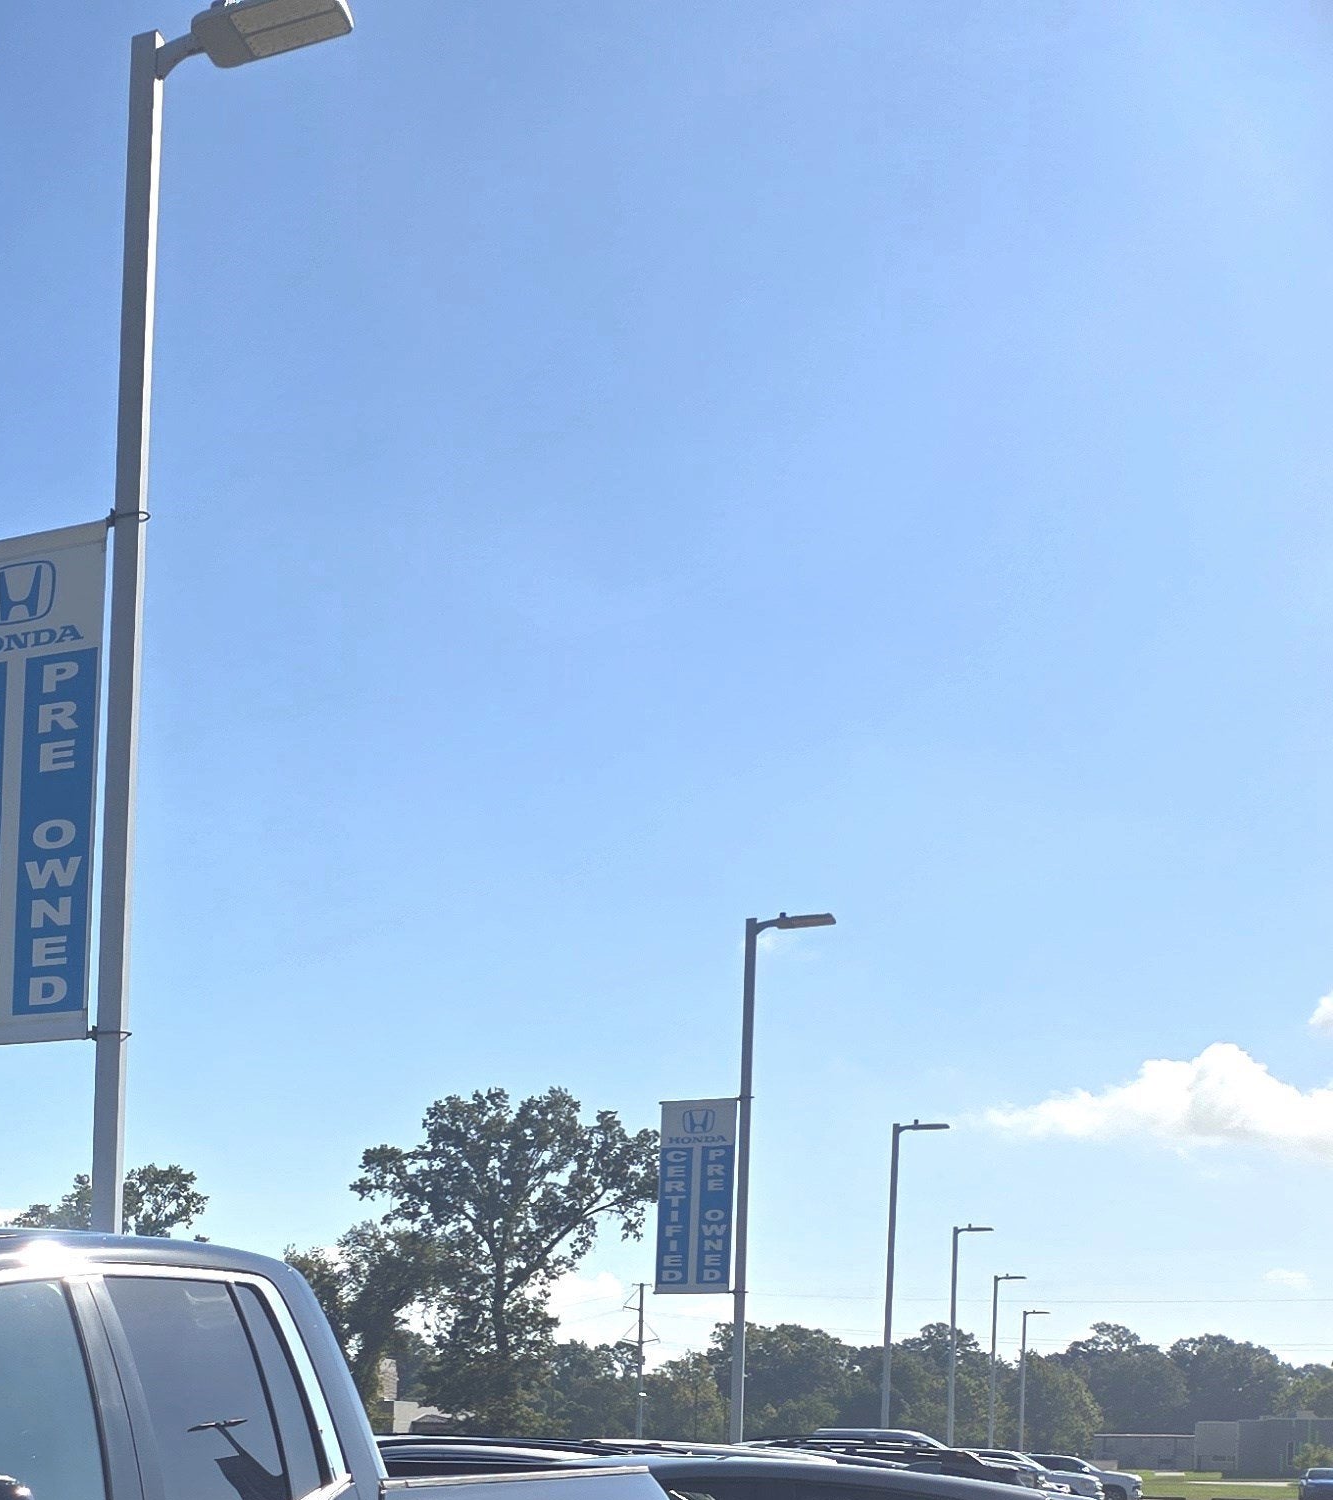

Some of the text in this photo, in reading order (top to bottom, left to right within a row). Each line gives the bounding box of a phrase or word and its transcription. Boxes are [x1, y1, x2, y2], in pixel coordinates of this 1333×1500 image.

[25, 661, 82, 1008] PRE OWNED
[667, 1134, 728, 1145] HONDA
[661, 1150, 687, 1283] CERTIFIED
[701, 1148, 727, 1282] PRE OWNED
